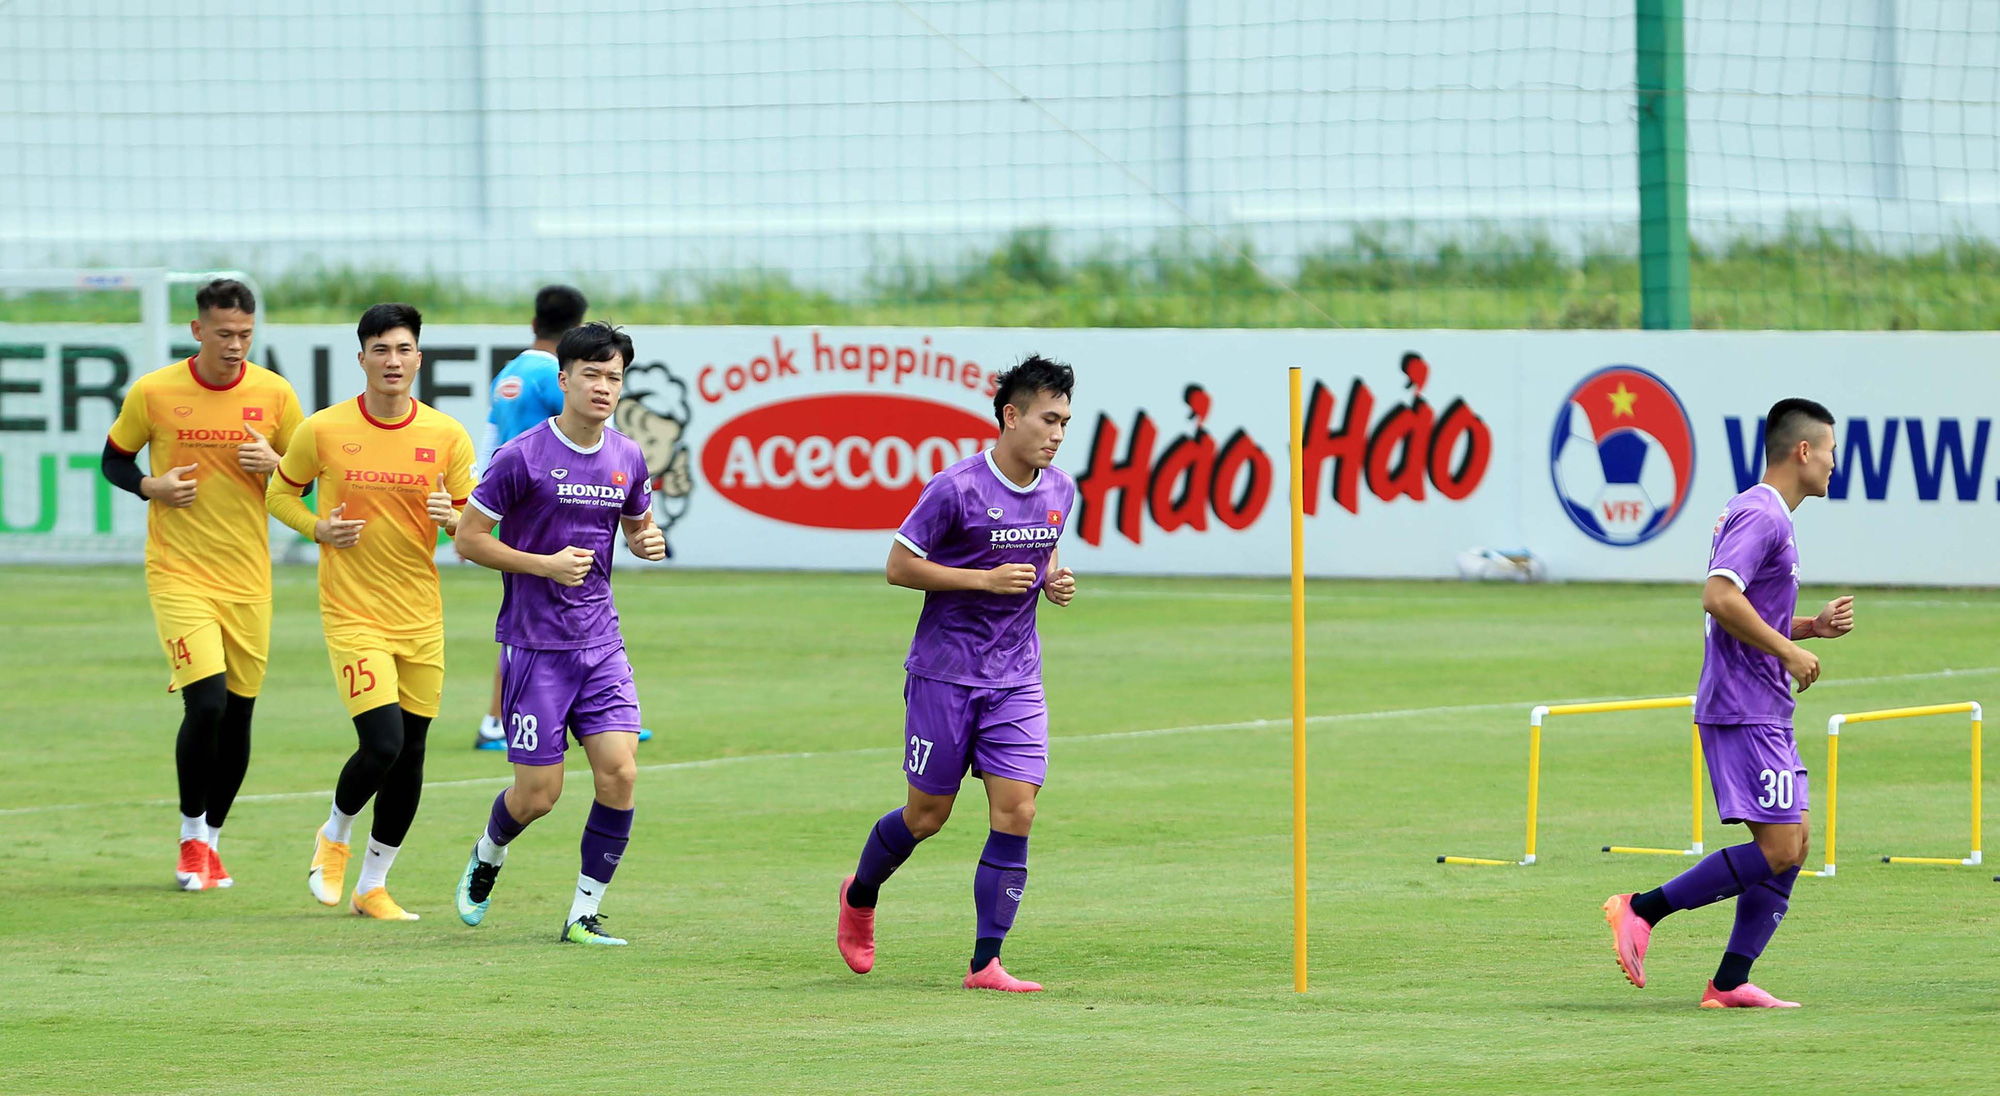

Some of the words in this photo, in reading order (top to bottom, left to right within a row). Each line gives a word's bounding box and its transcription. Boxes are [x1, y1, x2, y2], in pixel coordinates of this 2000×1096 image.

[698, 335, 799, 403] Cook
[812, 331, 999, 398] happines
[176, 429, 257, 442] HONDA
[1076, 383, 1274, 547] Hảo
[1289, 350, 1493, 517] Hảo
[1723, 416, 2000, 502] WW
[345, 469, 429, 486] HONDA
[557, 484, 625, 500] HONDA
[600, 500, 623, 508] Dreams
[1602, 501, 1644, 522] VFF
[989, 527, 1059, 542] HONDA
[991, 543, 1006, 551] The
[342, 656, 376, 699] 25
[511, 713, 539, 752] 28
[908, 734, 934, 776] 37
[1758, 768, 1794, 810] 30
